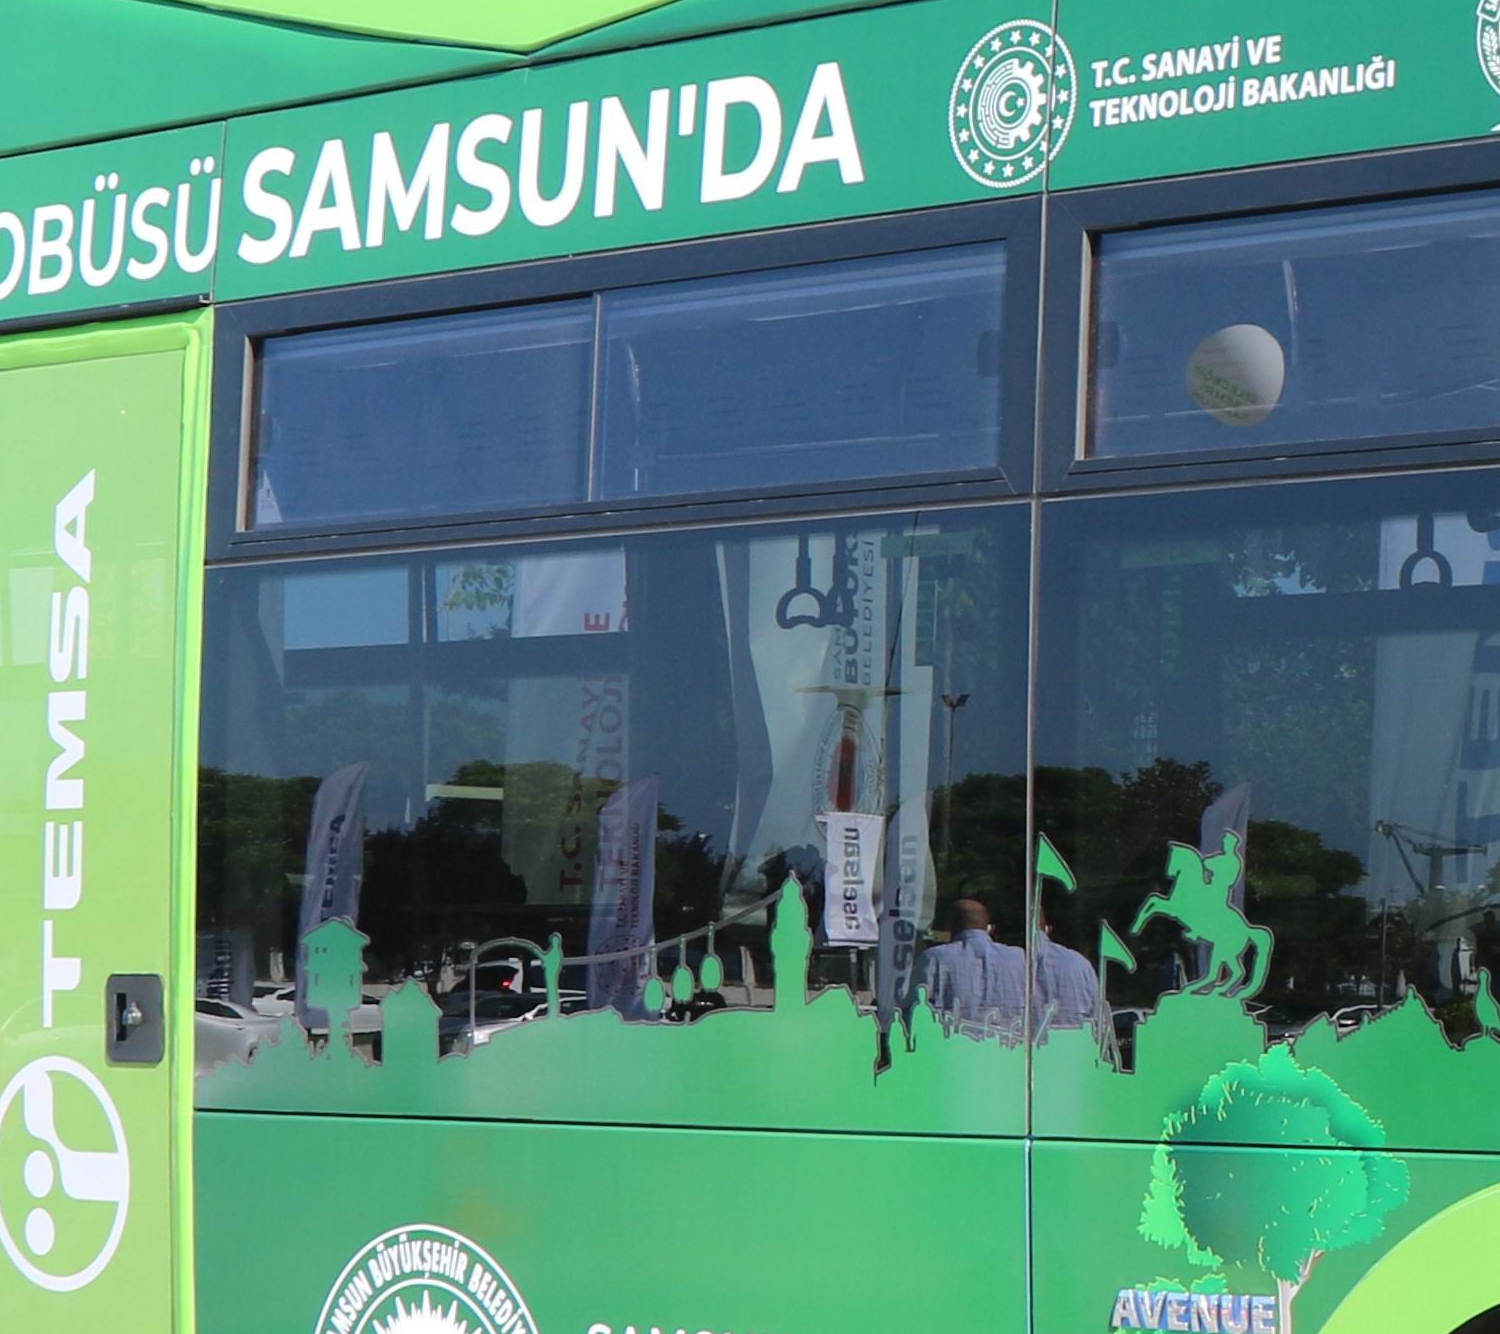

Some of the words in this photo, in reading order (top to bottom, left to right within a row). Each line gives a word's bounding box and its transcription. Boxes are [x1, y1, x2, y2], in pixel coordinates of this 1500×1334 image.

[1088, 76, 1236, 127] TEKNOLOJİ
[1243, 55, 1395, 107] BAKANLIĞI
[1091, 57, 1136, 88] T.C.
[1142, 35, 1239, 81] SANAYİ
[1246, 35, 1281, 65] VE
[238, 62, 864, 264] SAMSUN'DA
[43, 467, 97, 1029] TEMSA
[368, 1233, 469, 1285] BÜYÜKŞEHİR
[1111, 1289, 1277, 1334] AVENUE
